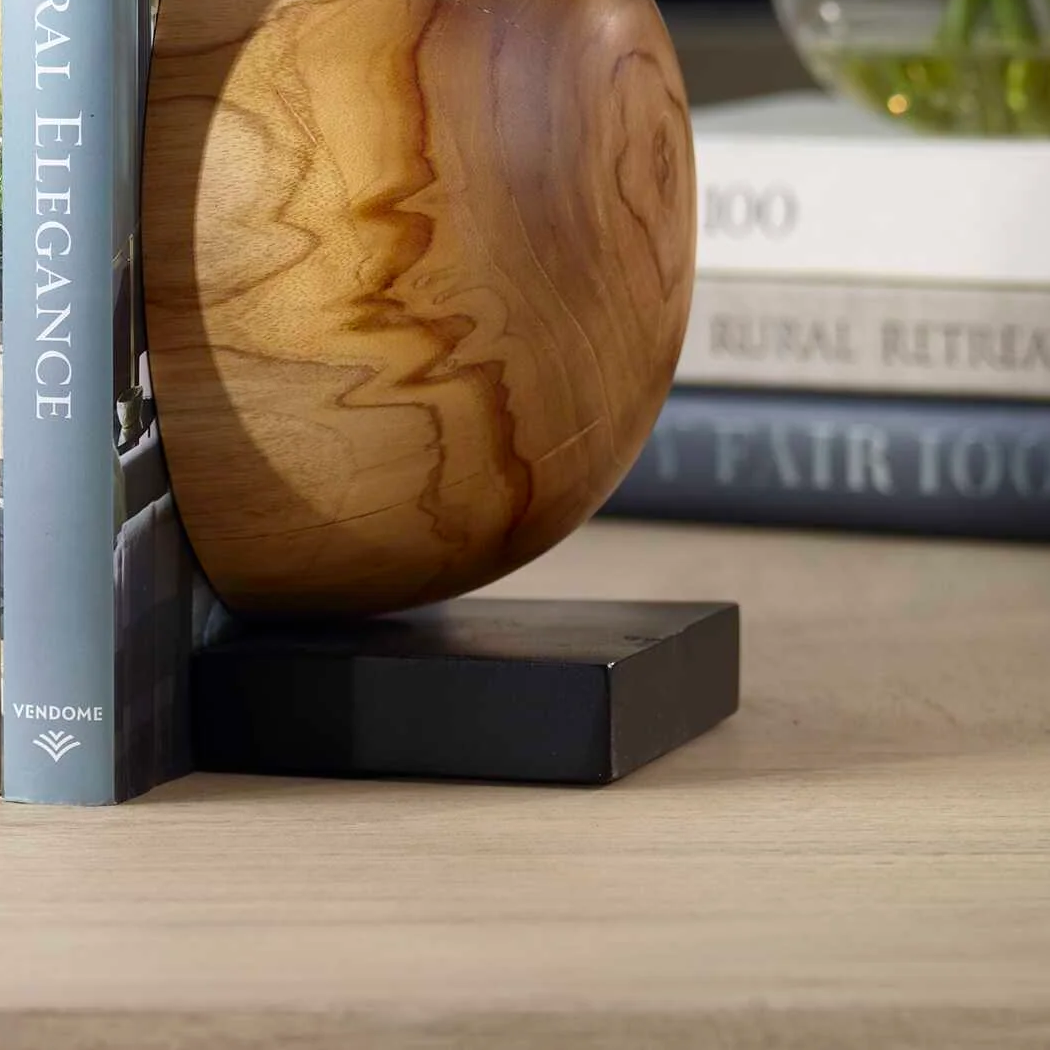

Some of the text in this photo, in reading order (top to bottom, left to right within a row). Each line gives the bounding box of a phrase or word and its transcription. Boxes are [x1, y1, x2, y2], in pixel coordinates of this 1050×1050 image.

[35, 109, 83, 420] ELEGANCE
[708, 312, 857, 365] RURAL
[714, 420, 894, 496] FAIR
[12, 703, 103, 722] VENDOME
